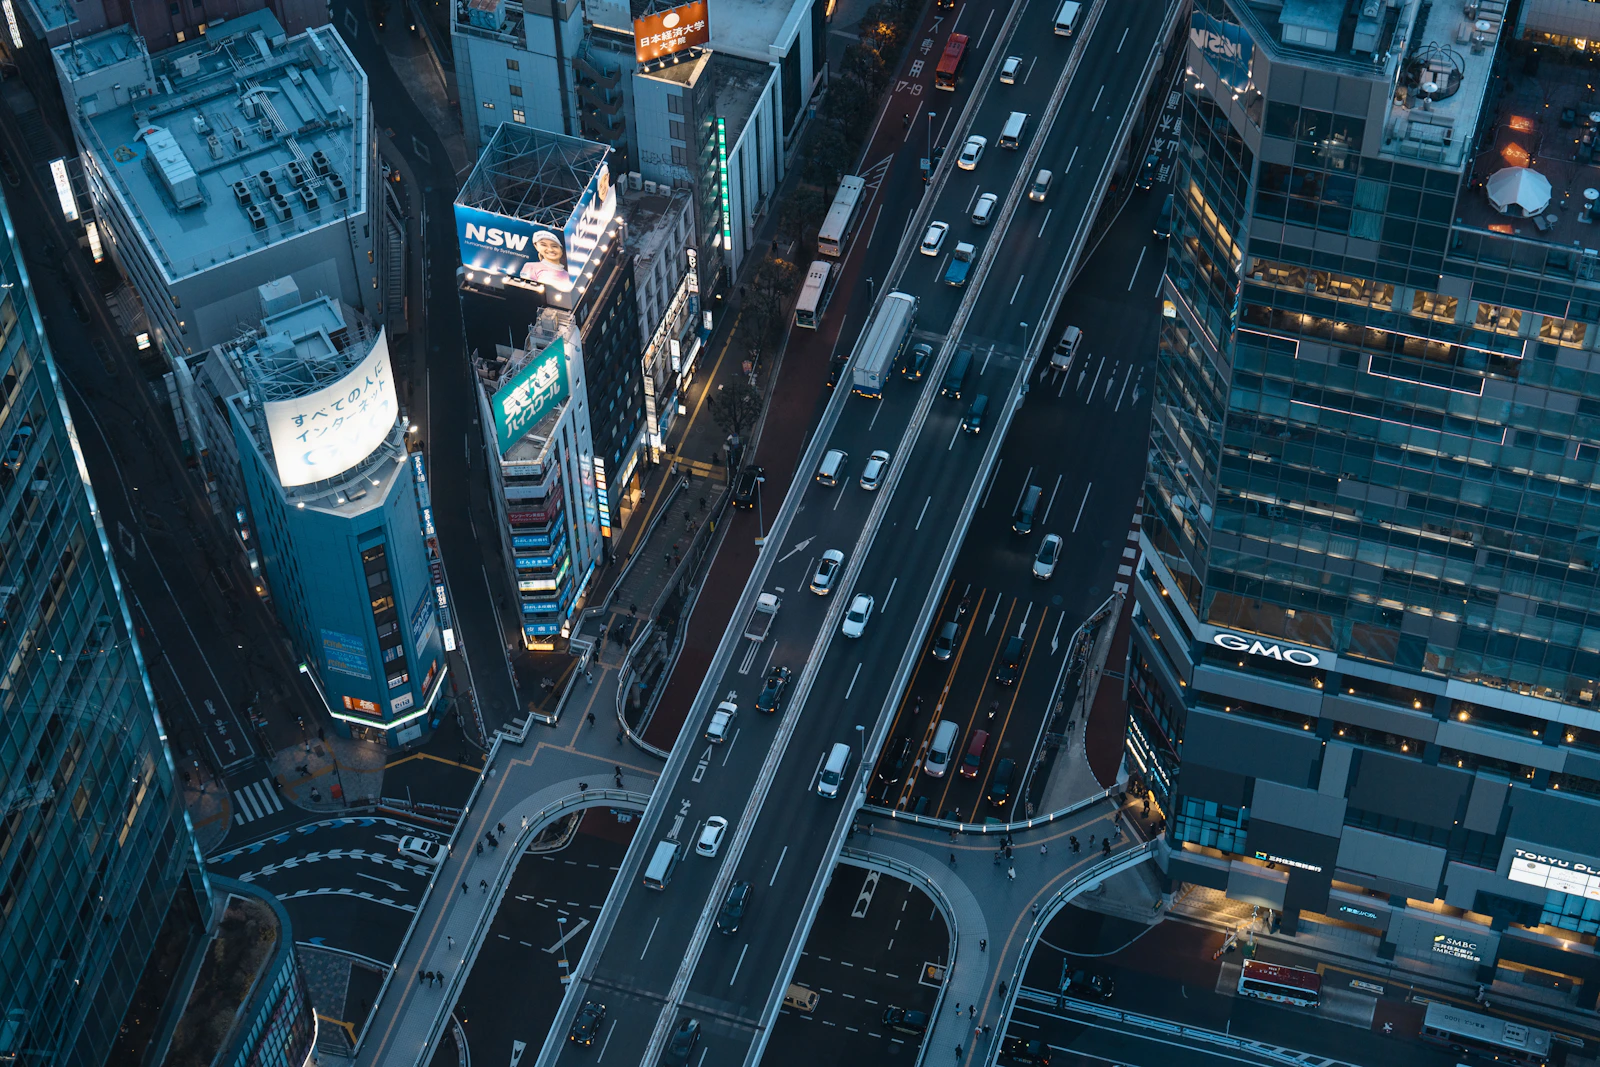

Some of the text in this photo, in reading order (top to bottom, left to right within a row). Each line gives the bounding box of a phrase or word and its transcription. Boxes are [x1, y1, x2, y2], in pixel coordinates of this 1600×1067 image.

[640, 20, 705, 47] 日本経済大学
[659, 36, 687, 50] 大学院
[895, 80, 923, 96] 17-19
[464, 239, 493, 251] Humanware
[499, 248, 530, 259] Systemware
[465, 222, 529, 251] NSW
[291, 359, 383, 428] すべての人に
[502, 355, 560, 425] 東進
[296, 379, 386, 443] インターネット
[507, 382, 561, 439] ハイスクール
[1213, 633, 1320, 667] GMO
[394, 698, 410, 709] ena
[1515, 848, 1569, 868] TOKYU
[1446, 937, 1477, 950] SMBC
